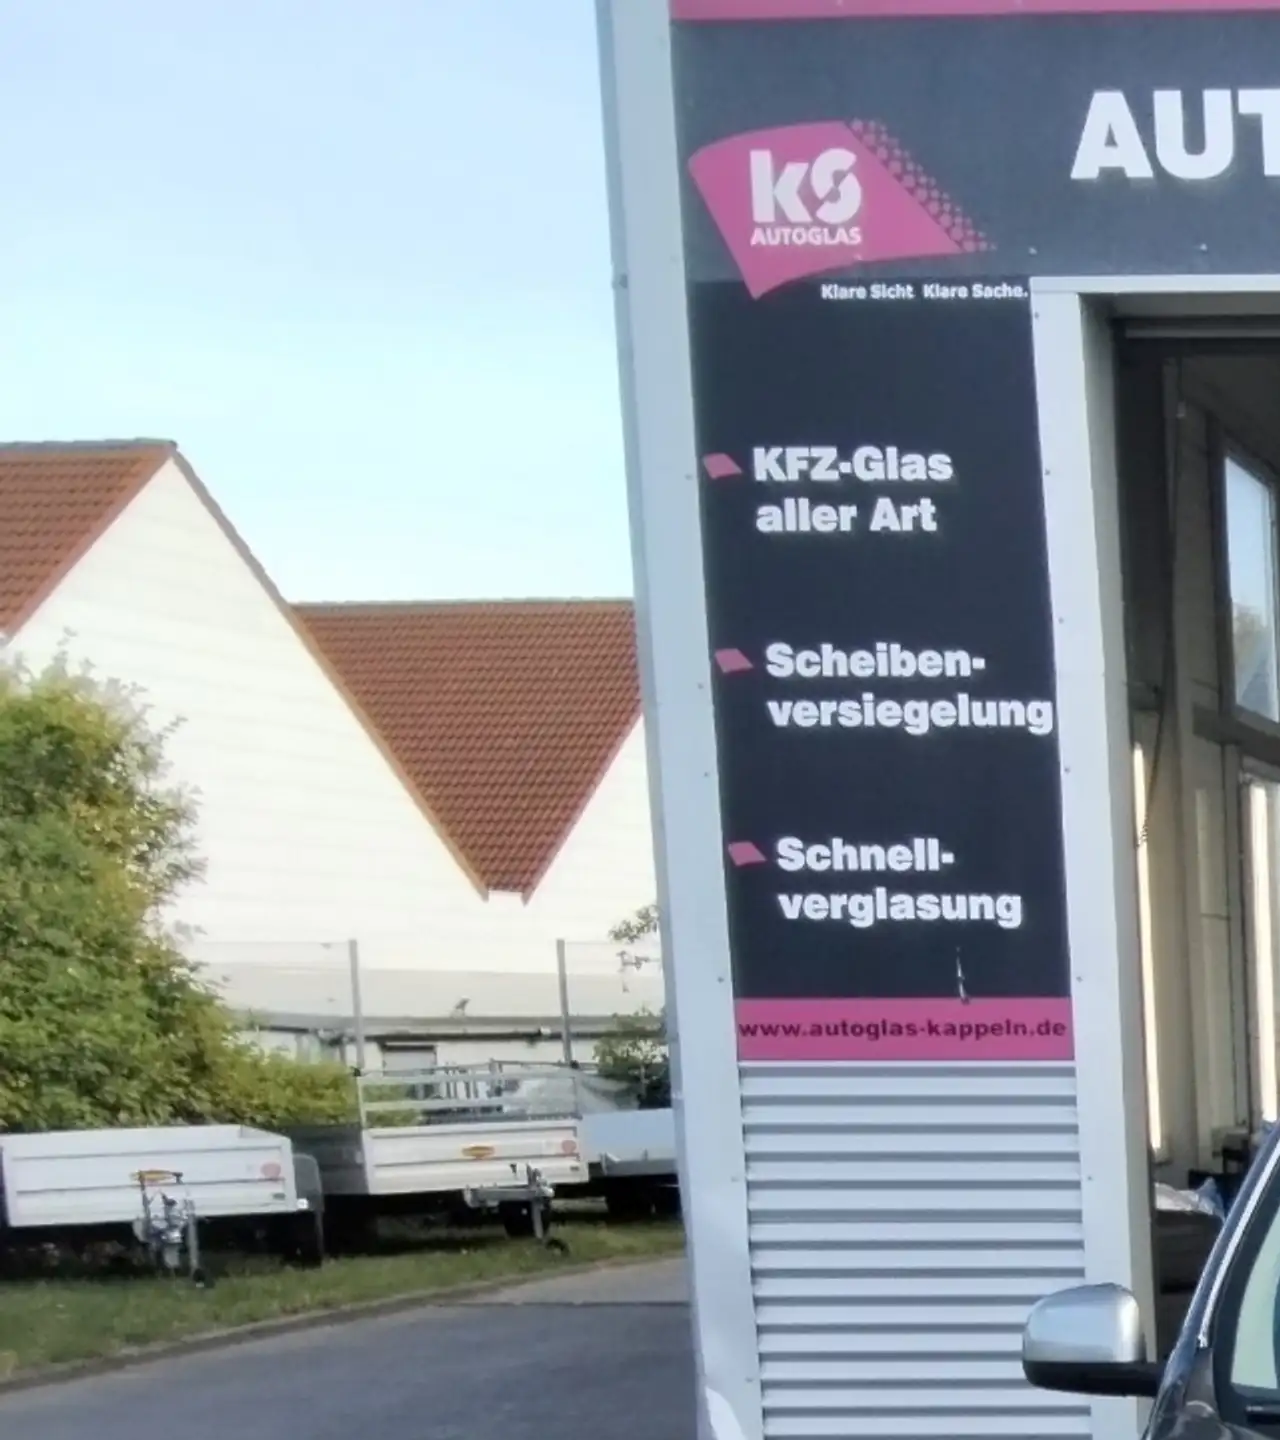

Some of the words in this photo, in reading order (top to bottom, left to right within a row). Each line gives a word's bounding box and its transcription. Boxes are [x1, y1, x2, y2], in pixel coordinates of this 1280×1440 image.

[750, 226, 863, 246] AUTOGLAS
[821, 284, 867, 299] Klare
[923, 283, 970, 299] Klare
[972, 282, 1029, 298] Sache.
[752, 447, 953, 484] KFZ-Glas
[755, 497, 858, 533] aller
[869, 497, 937, 533] Art
[765, 642, 986, 678] Scheiben-
[767, 693, 1054, 736] versiegelung
[776, 837, 955, 872] Schnell-
[778, 887, 1023, 928] verglasung
[738, 1018, 1067, 1042] www.autoglas-kappeln.de
